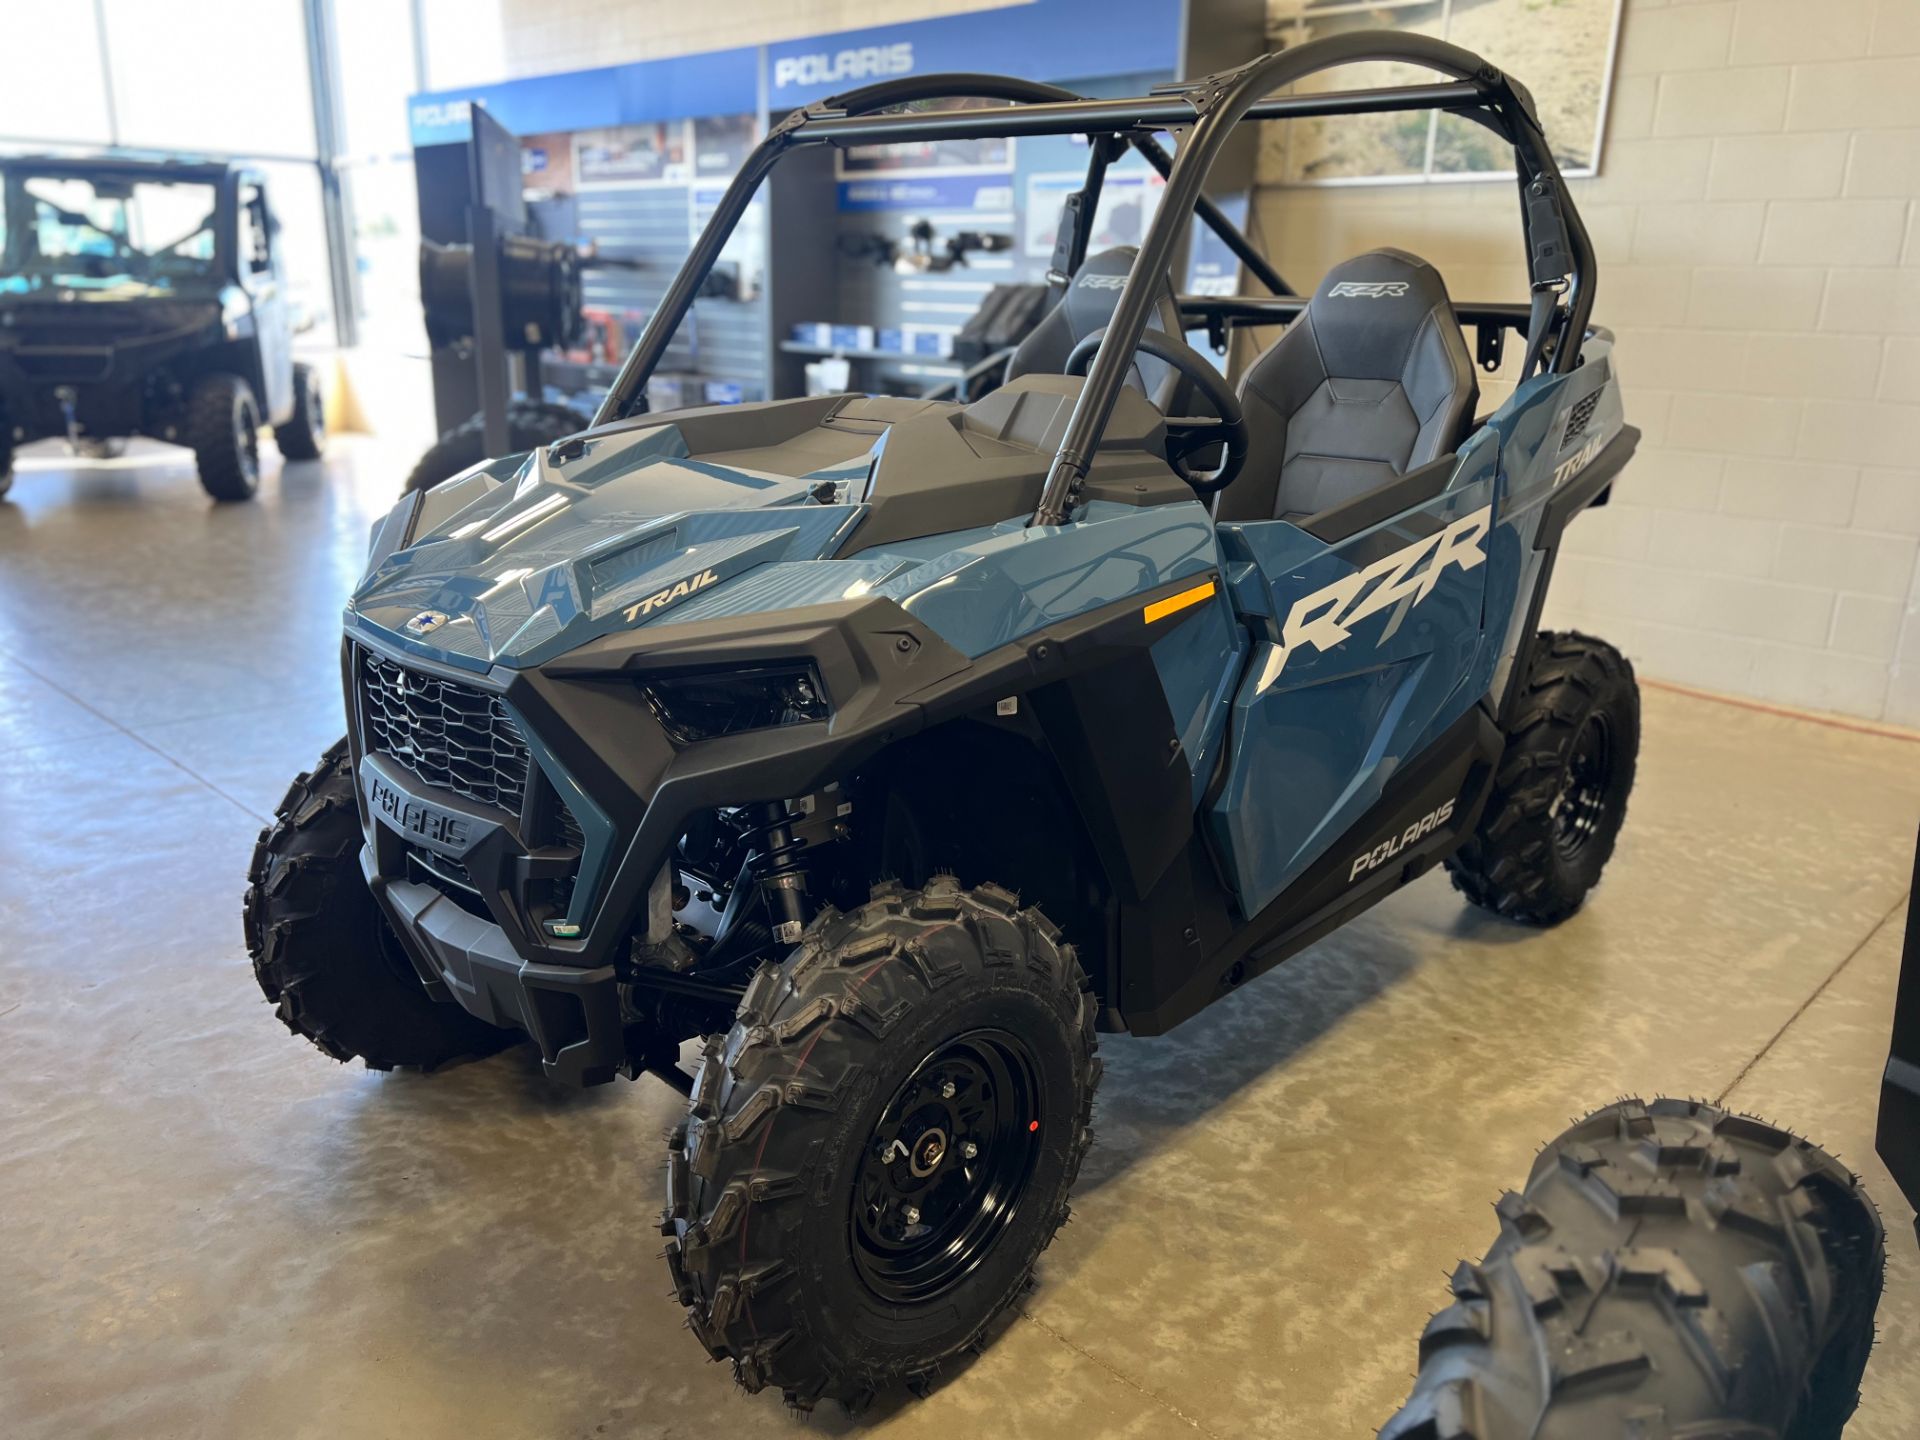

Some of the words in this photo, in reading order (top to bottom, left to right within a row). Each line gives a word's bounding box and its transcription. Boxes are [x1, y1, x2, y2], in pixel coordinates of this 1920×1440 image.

[775, 42, 914, 88] POLARIS
[1328, 281, 1410, 298] RZR
[623, 569, 718, 623] TRAIL
[1255, 504, 1492, 696] RZR
[371, 778, 469, 850] POLARIS
[1348, 797, 1456, 882] POLARIS
